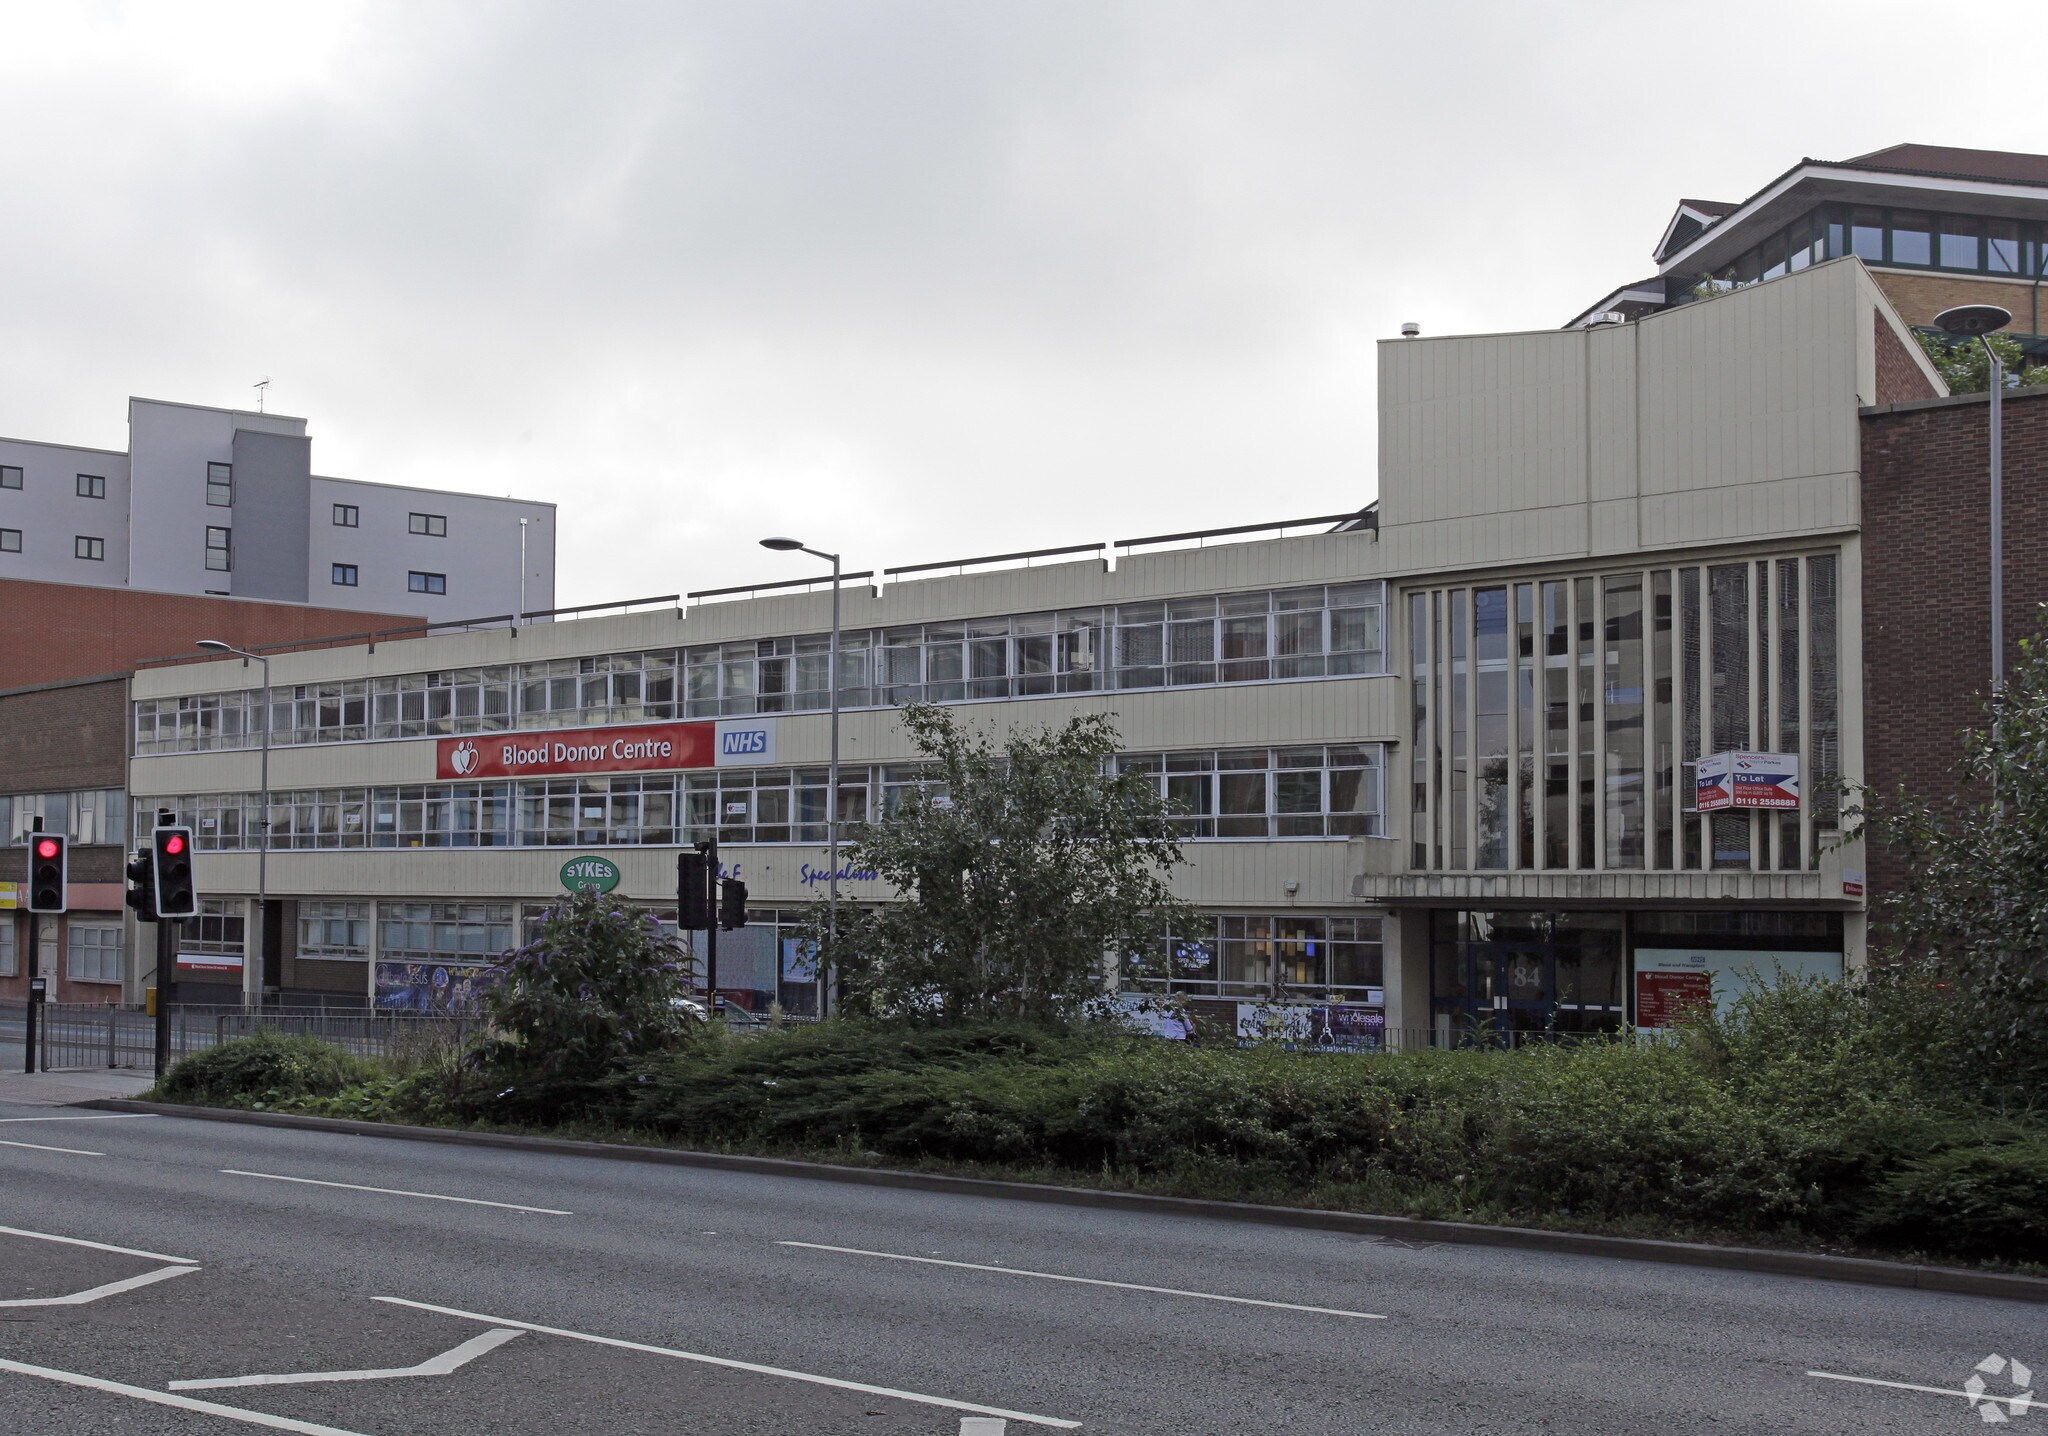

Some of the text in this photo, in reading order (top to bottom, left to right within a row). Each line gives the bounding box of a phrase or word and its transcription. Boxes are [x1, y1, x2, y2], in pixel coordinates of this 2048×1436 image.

[503, 739, 672, 765] Blood Donor Centre
[724, 731, 765, 753] NHS
[1735, 774, 1765, 783] To Let
[1736, 797, 1796, 806] 0116 2558888
[567, 861, 613, 877] SYKES
[801, 862, 878, 887] Specalists
[1514, 966, 1541, 987] 84
